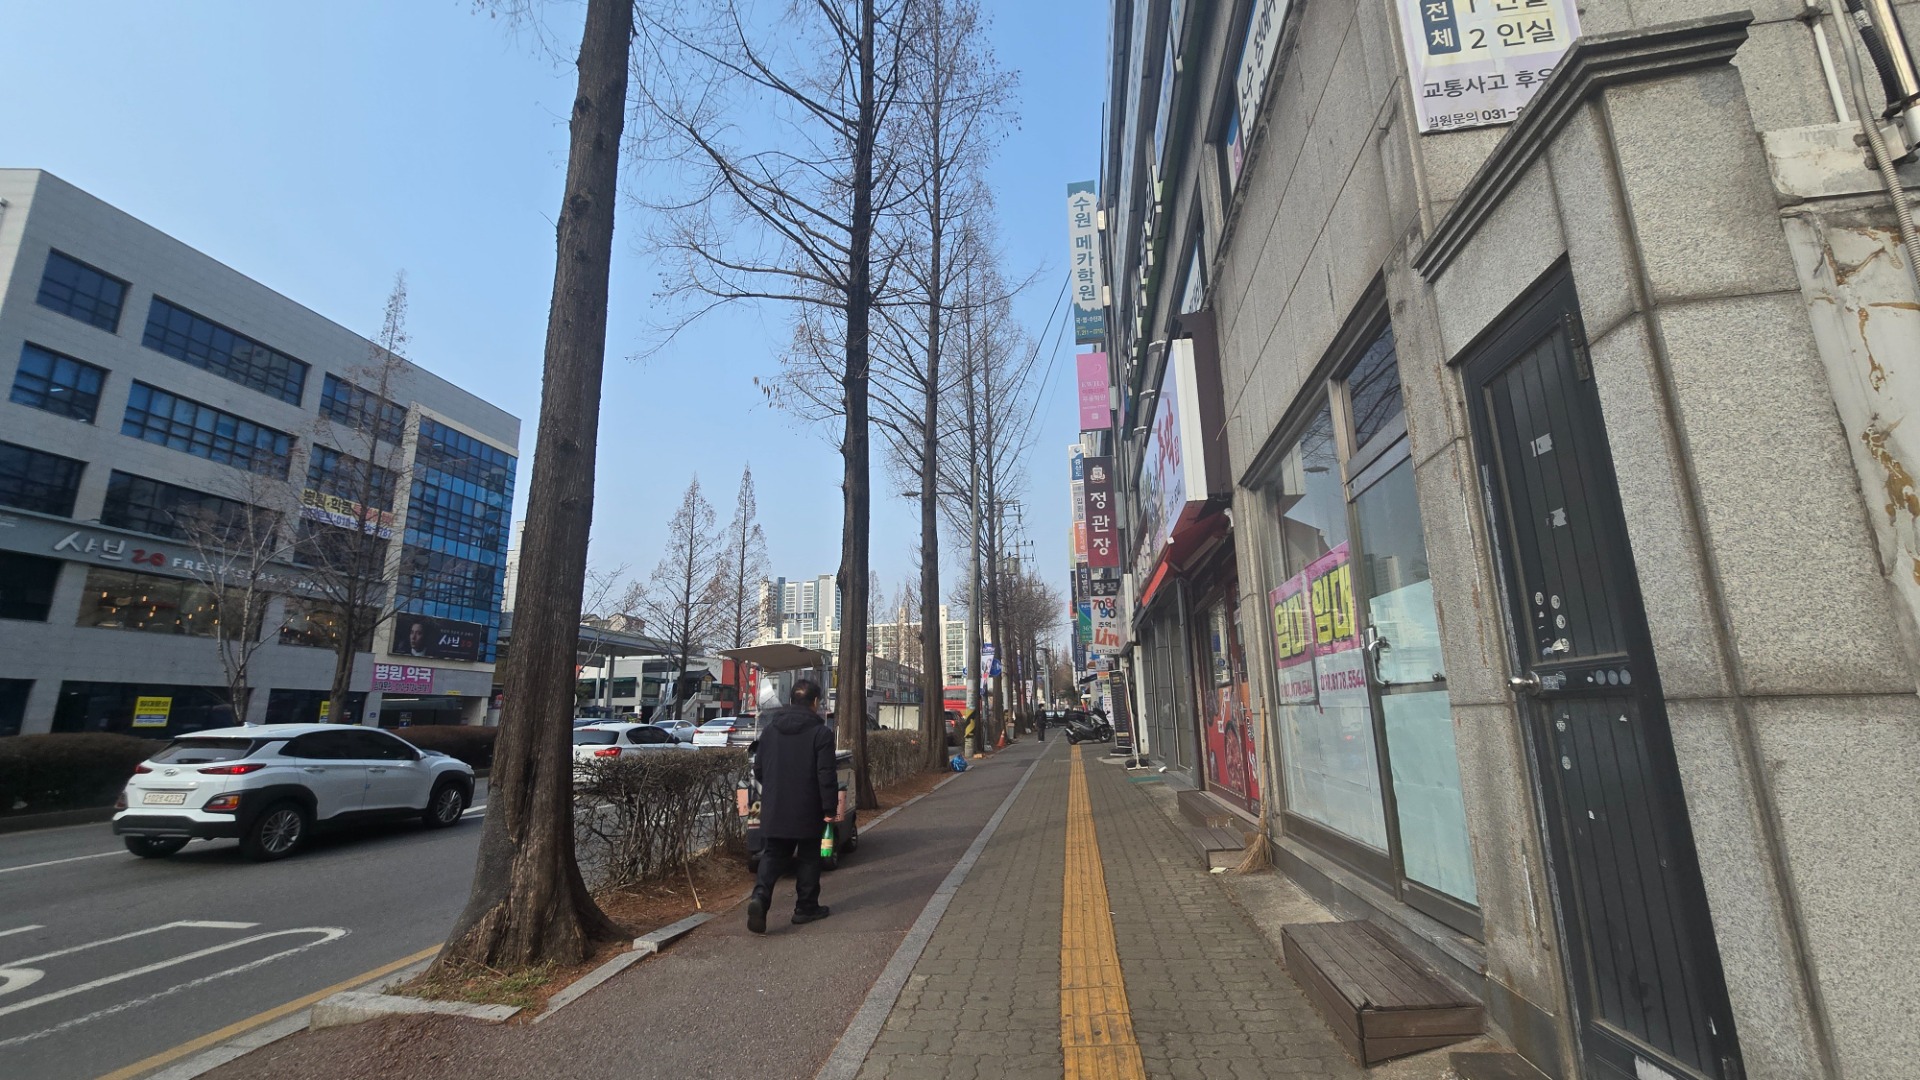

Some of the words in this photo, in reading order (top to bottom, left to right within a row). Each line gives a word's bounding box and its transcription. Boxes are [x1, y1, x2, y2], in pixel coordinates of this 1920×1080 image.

[1426, 2, 1454, 48] 전체
[1469, 28, 1488, 50] 2
[1496, 18, 1556, 47] 인실
[1423, 73, 1509, 98] 교통사고
[1073, 196, 1091, 229] 수원
[1075, 234, 1096, 301] 메카학원
[1090, 491, 1111, 556] 정관장
[54, 531, 126, 561] 샤브
[1100, 608, 1117, 619] 90
[1311, 562, 1356, 646] 임대
[375, 664, 432, 683] 병원.약국
